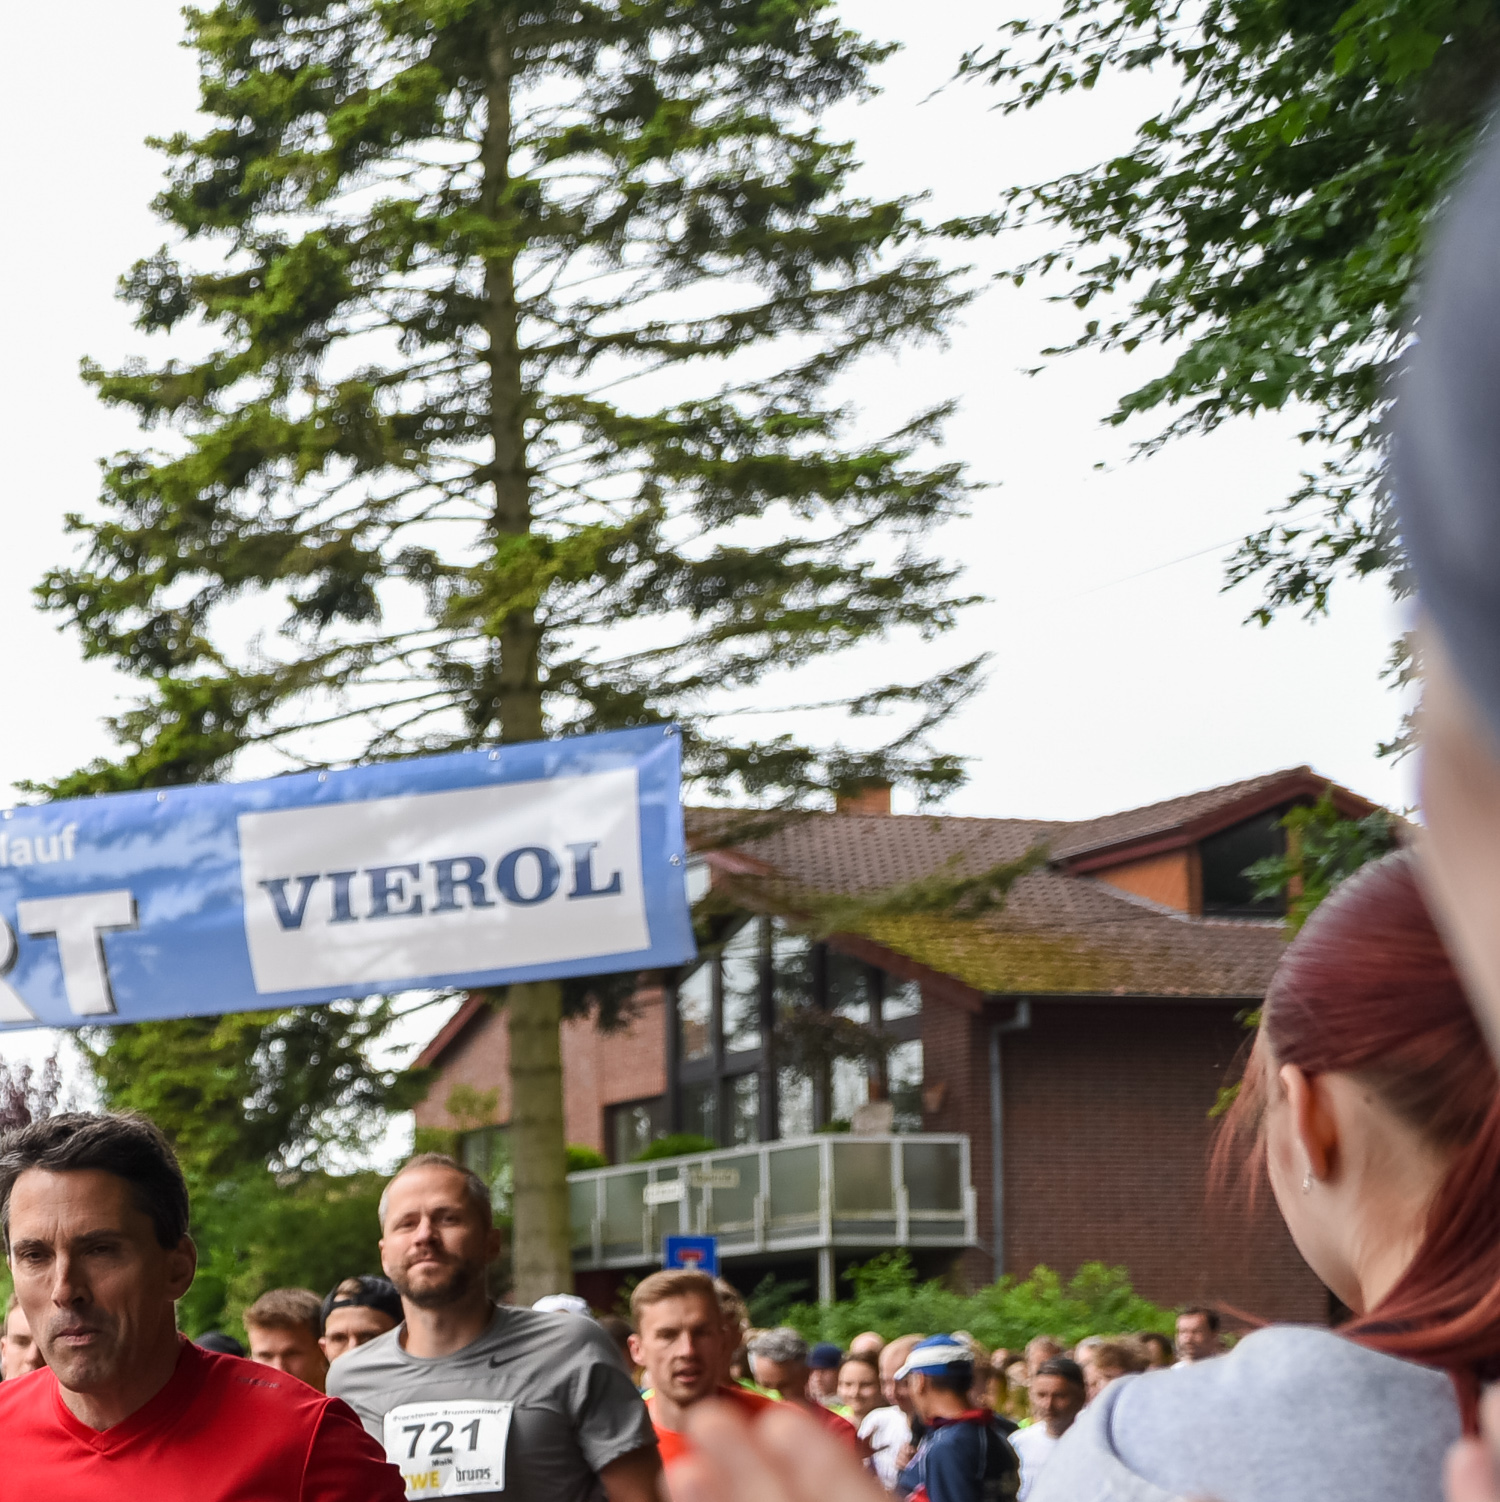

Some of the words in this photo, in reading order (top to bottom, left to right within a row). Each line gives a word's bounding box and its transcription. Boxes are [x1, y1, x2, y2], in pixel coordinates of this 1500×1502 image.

[258, 842, 622, 932] VIEROL
[402, 1418, 481, 1459] 721
[405, 1470, 440, 1491] WE
[455, 1467, 491, 1482] bruns
